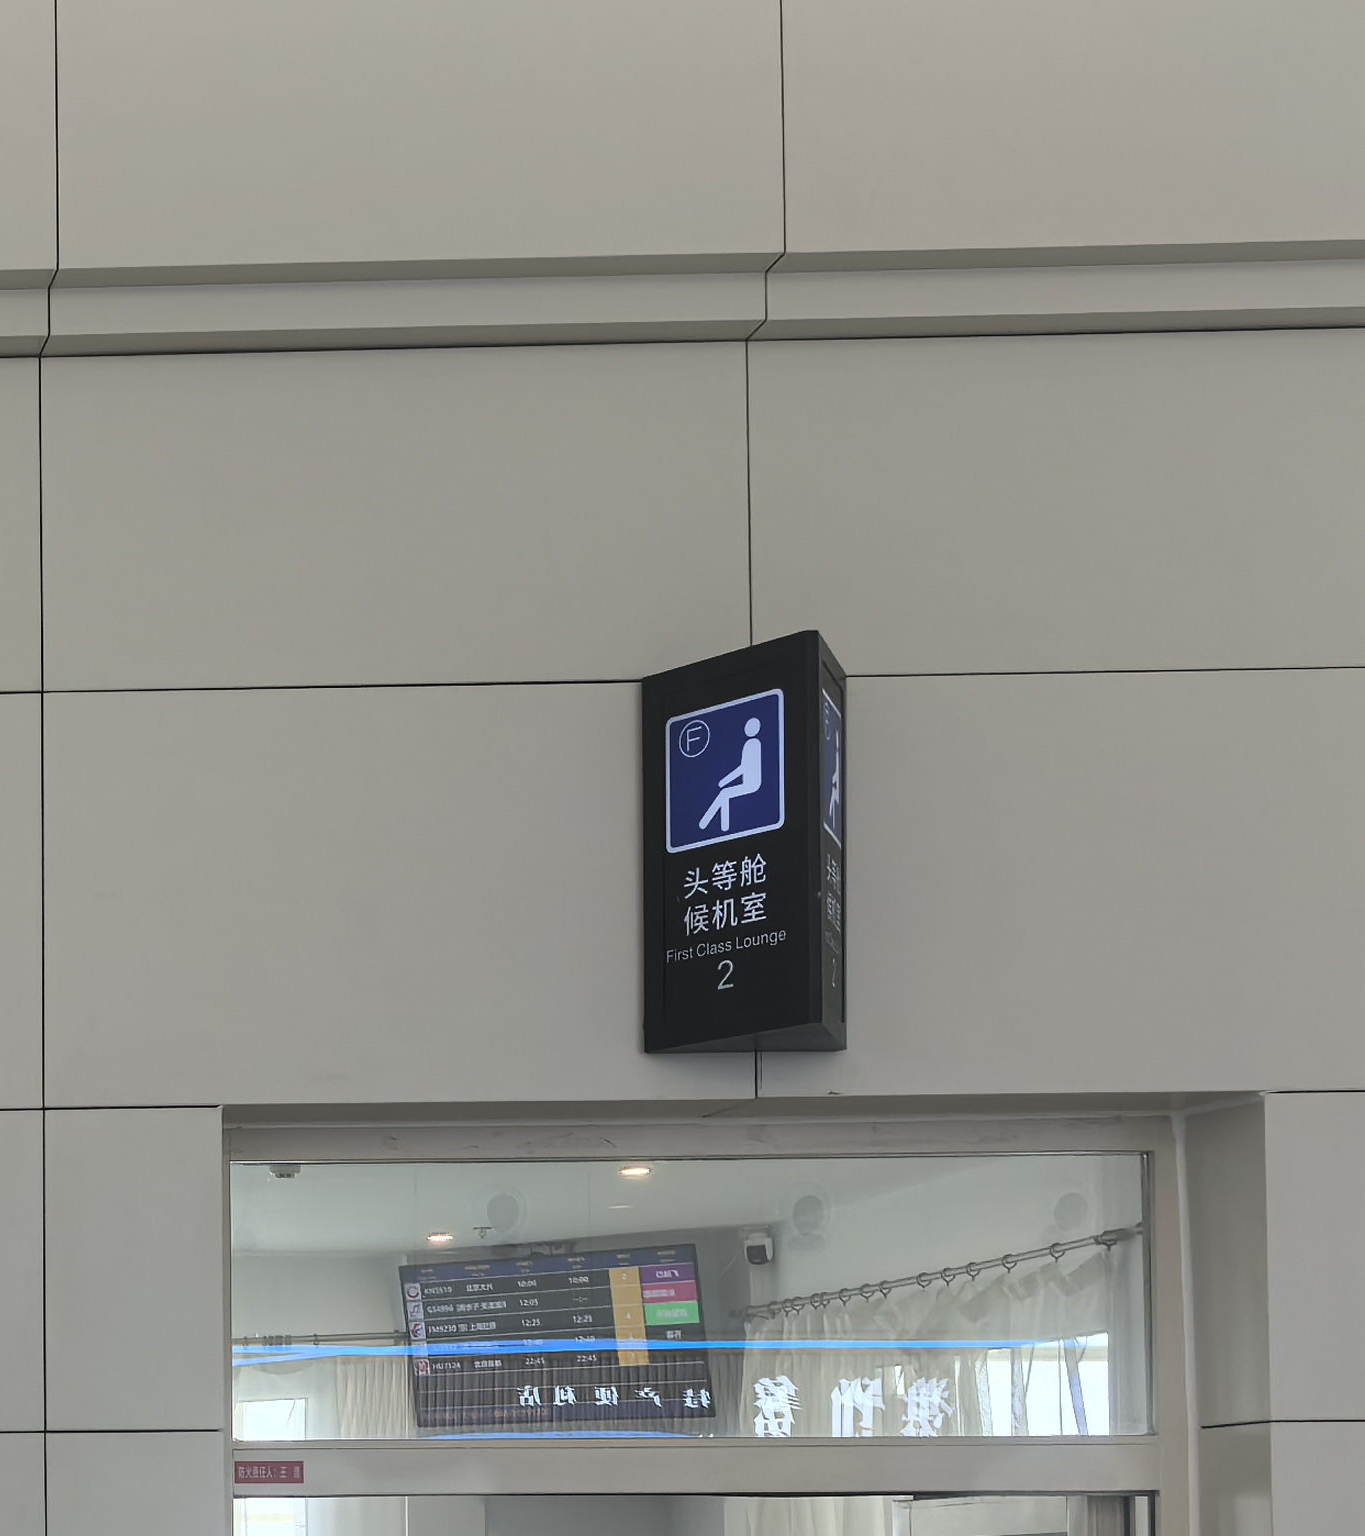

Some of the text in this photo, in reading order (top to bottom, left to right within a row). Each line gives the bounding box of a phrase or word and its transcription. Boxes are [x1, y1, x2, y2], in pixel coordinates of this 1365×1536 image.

[685, 726, 702, 751] F
[684, 853, 767, 899] 头等舱
[684, 892, 767, 936] 候机室
[666, 930, 787, 963] First Class Lounge
[717, 960, 734, 990] 2
